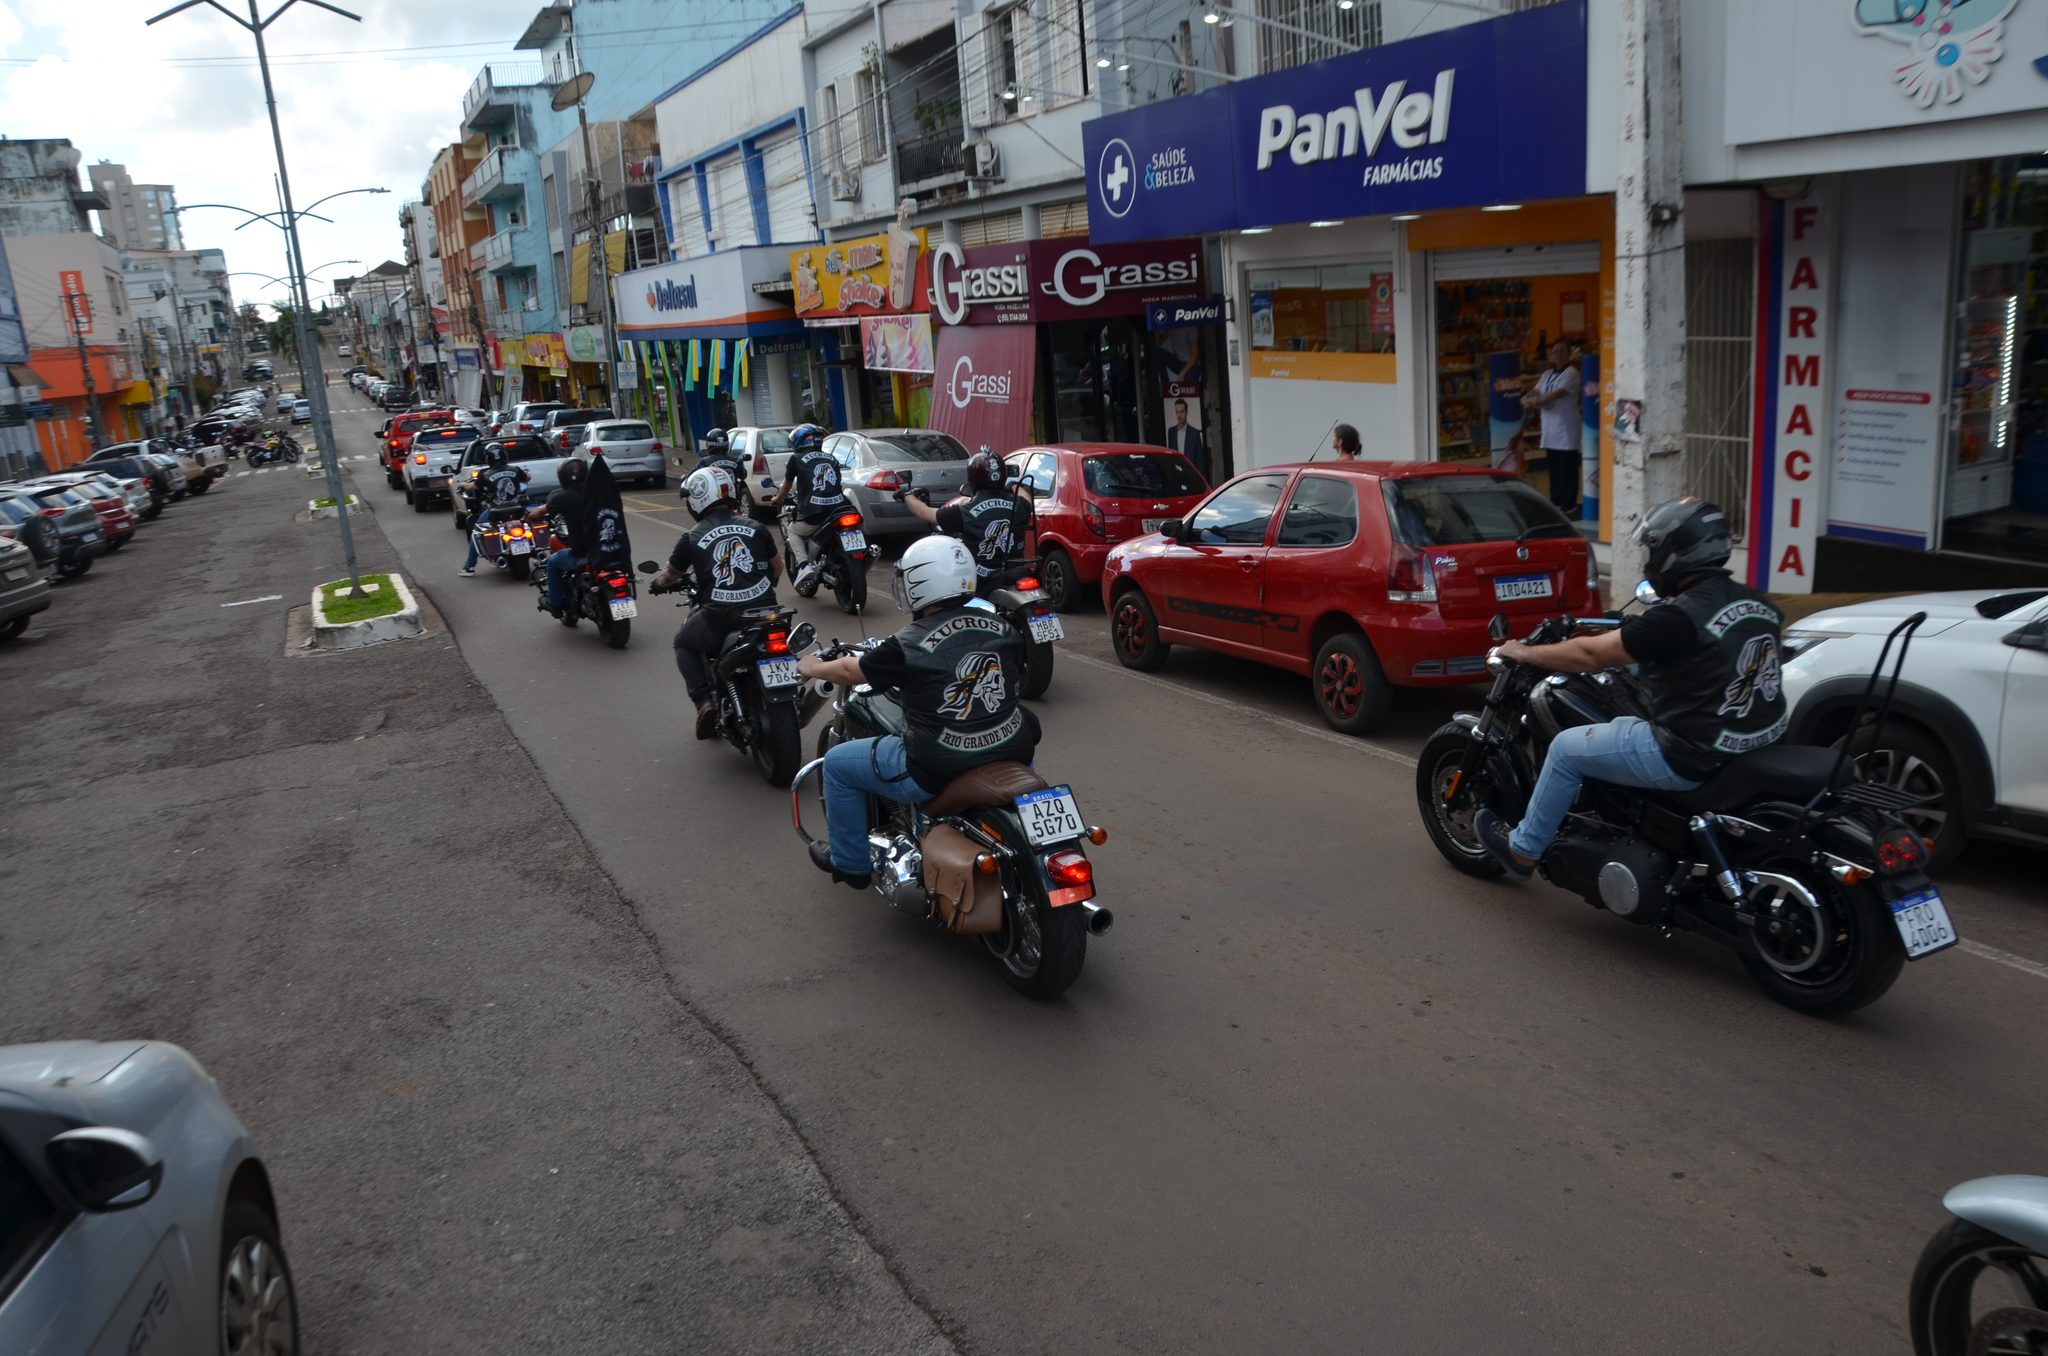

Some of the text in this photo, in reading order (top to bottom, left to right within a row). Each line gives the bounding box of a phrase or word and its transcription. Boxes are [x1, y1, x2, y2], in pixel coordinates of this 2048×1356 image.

[1257, 68, 1456, 171] PanVel
[1152, 147, 1187, 171] SAÚDE
[1362, 156, 1445, 188] FARMÁCIAS
[927, 242, 1030, 326] Grassi
[1040, 249, 1198, 306] Grassi
[655, 273, 698, 312] Deltasul
[1175, 306, 1219, 322] PanVel
[759, 339, 806, 355] Deltasul
[947, 355, 1011, 409] Grassi
[1777, 206, 1821, 577] FARMACIA
[974, 500, 1014, 514] XUCROS
[702, 526, 753, 546] XUCROS
[714, 590, 724, 602] RIO
[726, 589, 751, 602] GRANDE
[752, 586, 761, 597] DO
[1502, 581, 1547, 598] IRD4A21
[924, 617, 1001, 648] XUCROS
[1036, 619, 1054, 631] MBR
[1037, 629, 1061, 643] 5F51
[768, 662, 790, 674] IKV
[942, 732, 961, 748] RIO
[963, 730, 1000, 749] GRANDE
[1001, 724, 1013, 740] DO
[1032, 798, 1067, 820] AZQ
[1033, 793, 1054, 802] BRASIL
[1032, 813, 1077, 838] 5G70
